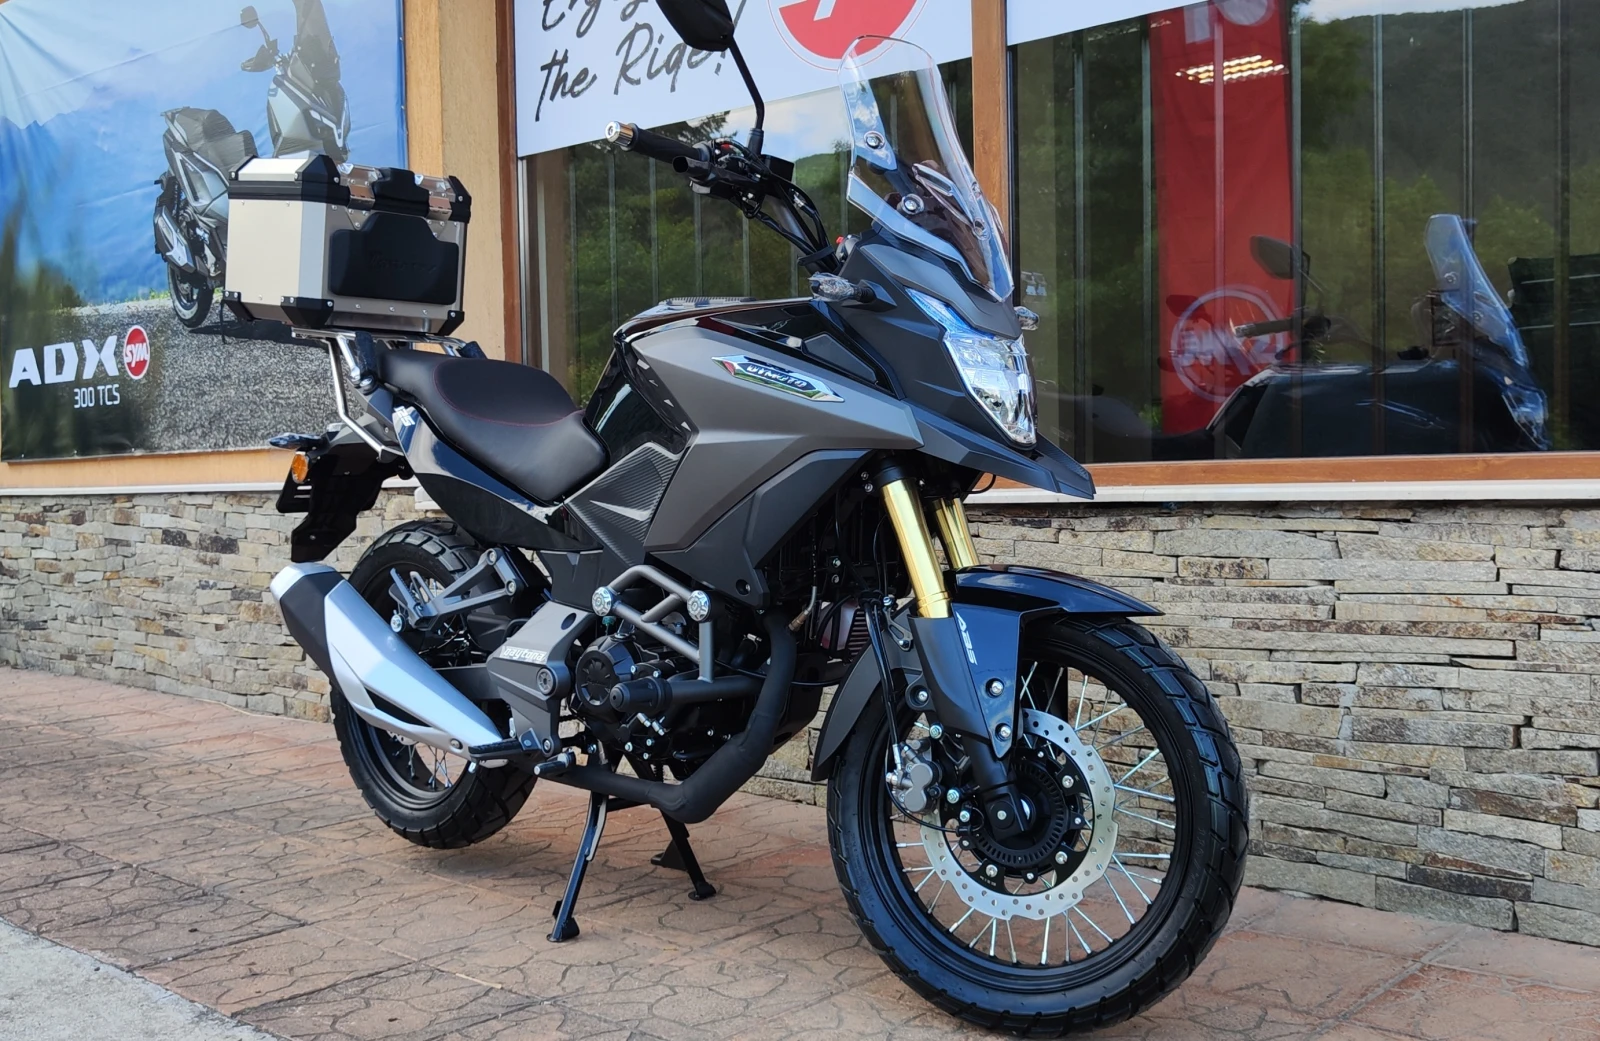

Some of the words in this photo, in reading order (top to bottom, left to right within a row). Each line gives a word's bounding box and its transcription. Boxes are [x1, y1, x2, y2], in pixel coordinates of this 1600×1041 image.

[535, 49, 597, 121] the
[9, 336, 119, 388] ADX
[125, 343, 149, 367] SYM
[74, 387, 95, 408] 300
[97, 384, 120, 405] TCS
[956, 611, 978, 666] ABS
